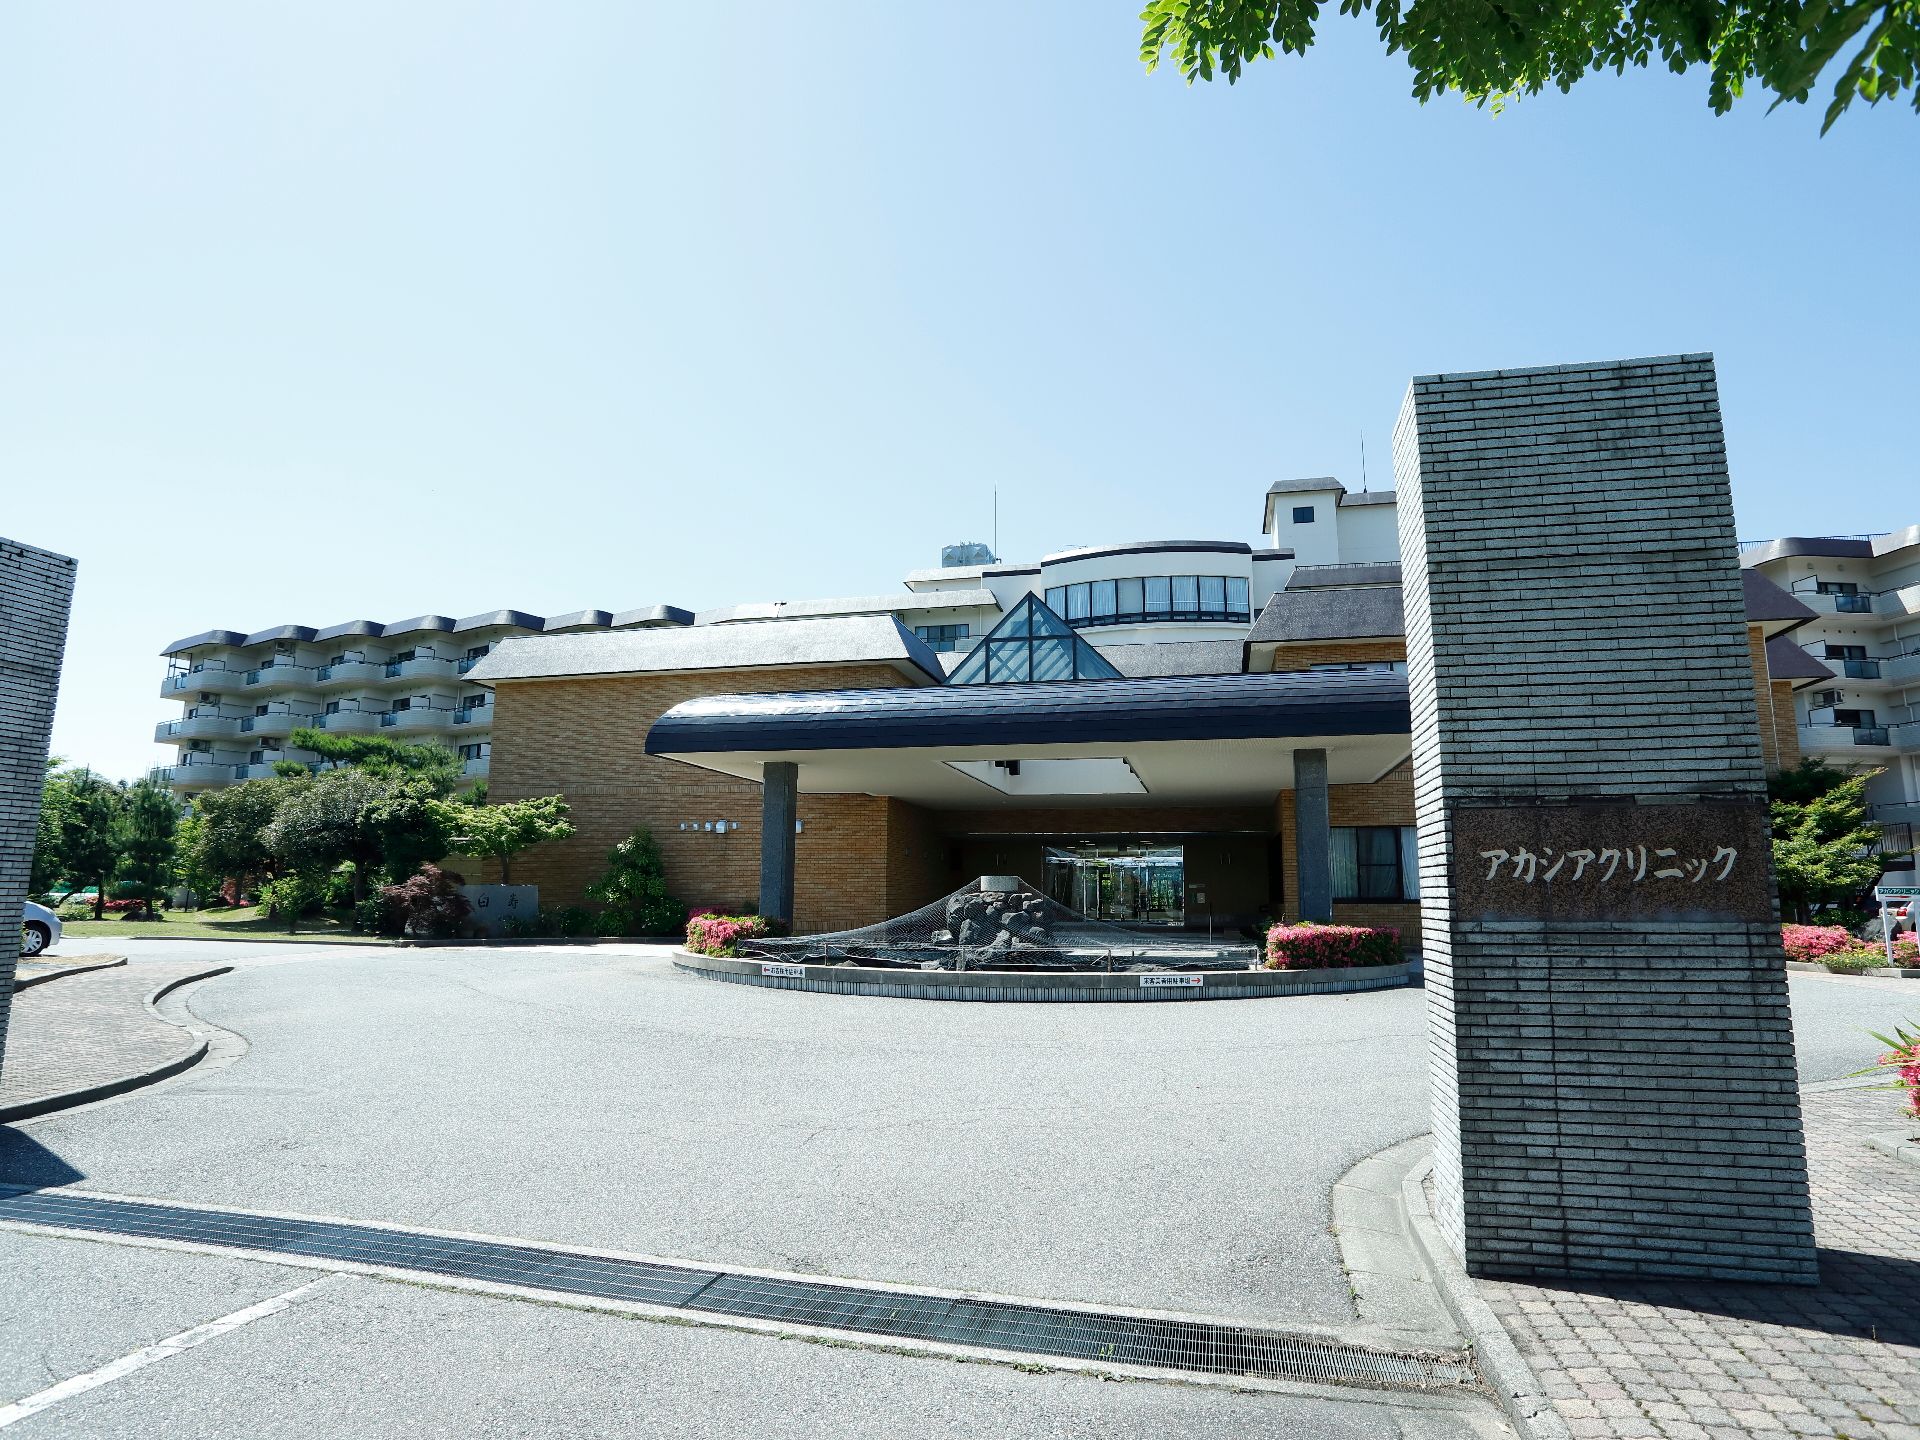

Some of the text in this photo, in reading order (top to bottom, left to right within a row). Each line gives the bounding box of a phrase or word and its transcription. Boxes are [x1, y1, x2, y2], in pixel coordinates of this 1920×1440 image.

[1480, 844, 1738, 883] アカシアクリニック
